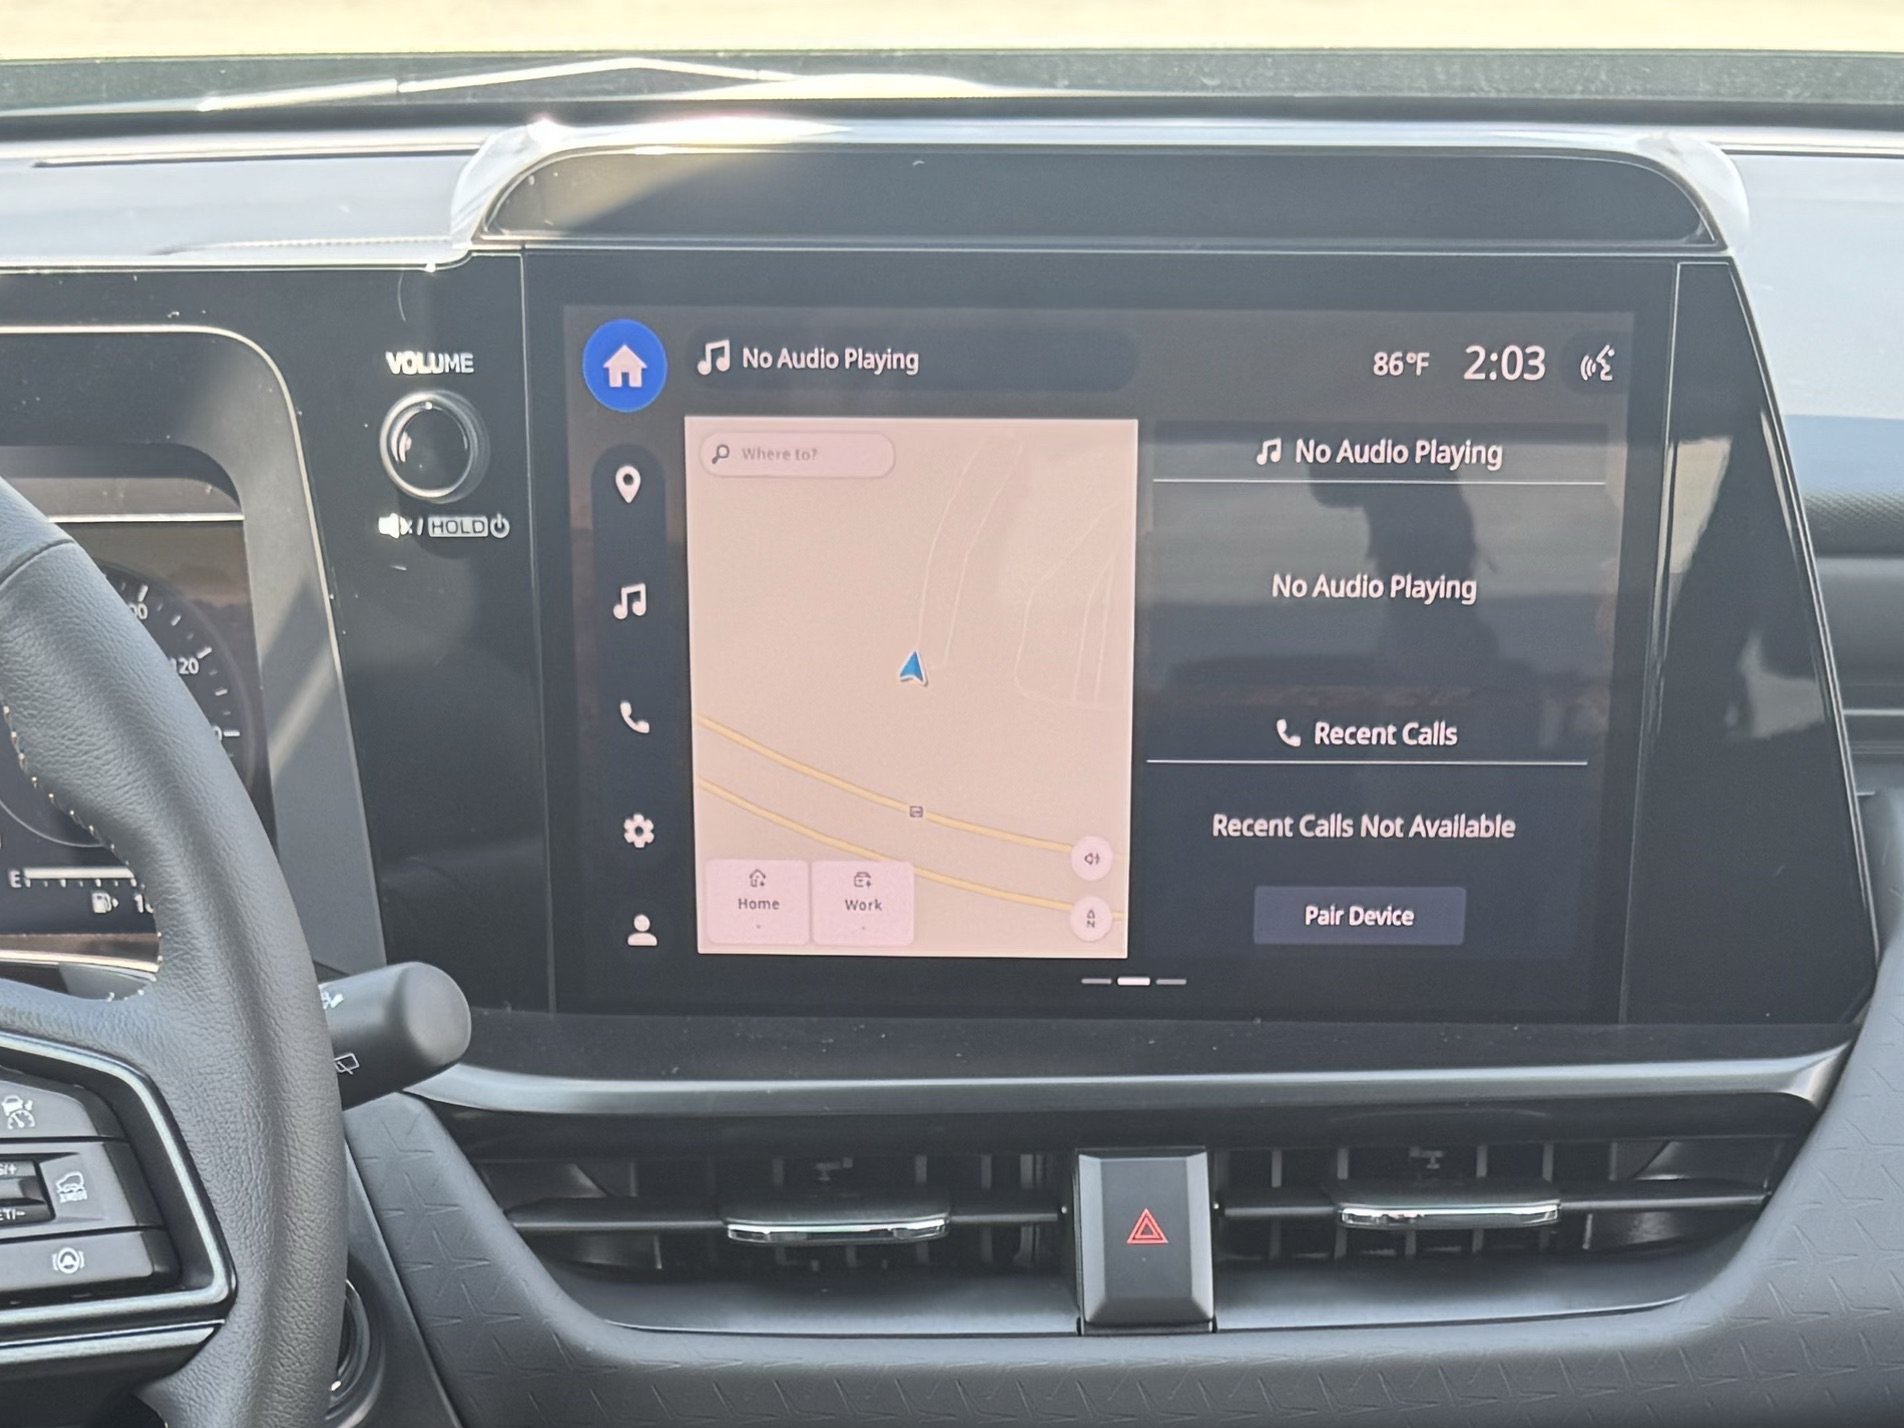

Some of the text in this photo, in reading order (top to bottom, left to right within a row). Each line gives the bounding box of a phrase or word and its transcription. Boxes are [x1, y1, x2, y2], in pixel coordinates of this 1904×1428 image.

[385, 351, 475, 375] VOLUME
[742, 347, 919, 375] No Audio Playing
[1373, 351, 1430, 376] 86°F
[1463, 345, 1546, 380] 2:03
[741, 447, 818, 461] Where to?
[1295, 439, 1503, 470] No Audio Playing
[430, 517, 486, 536] HOLD
[1272, 574, 1477, 605] No Audio Playing
[1314, 720, 1459, 746] Recent Calls
[1212, 813, 1516, 838] Recent Calls Not Available
[8, 870, 21, 888] E
[737, 897, 781, 911] Home
[844, 898, 883, 912] Work
[1305, 904, 1415, 926] Pair Device
